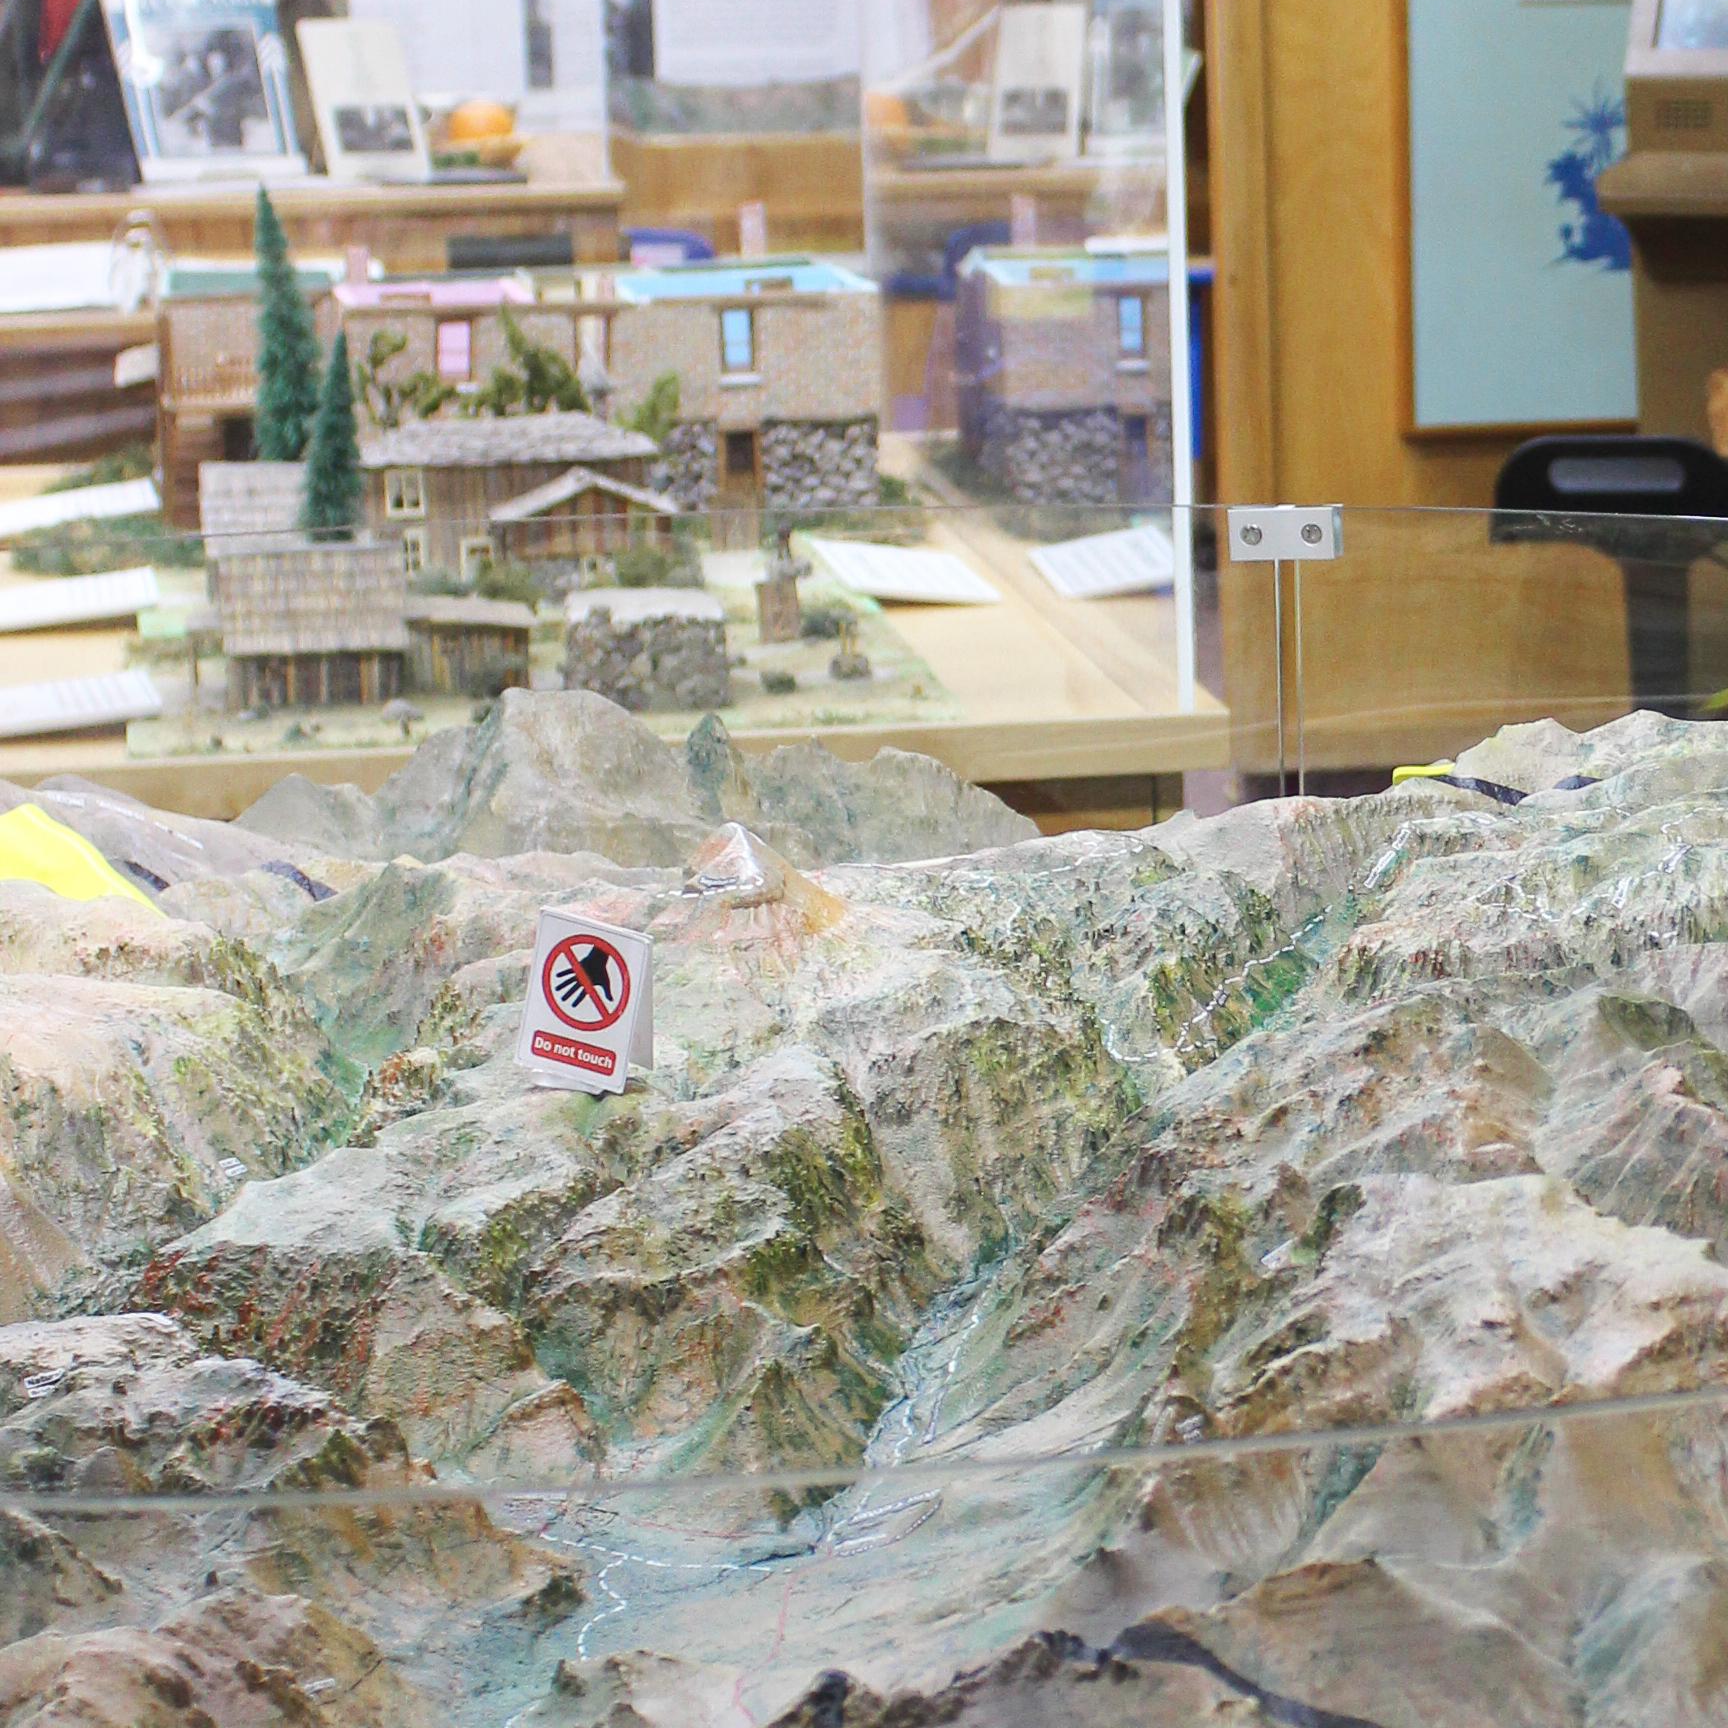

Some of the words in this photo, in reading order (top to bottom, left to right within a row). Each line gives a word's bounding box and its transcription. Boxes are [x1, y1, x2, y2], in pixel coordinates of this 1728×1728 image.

[534, 1036, 552, 1052] Do
[554, 1043, 576, 1058] not
[577, 1048, 612, 1068] touch
